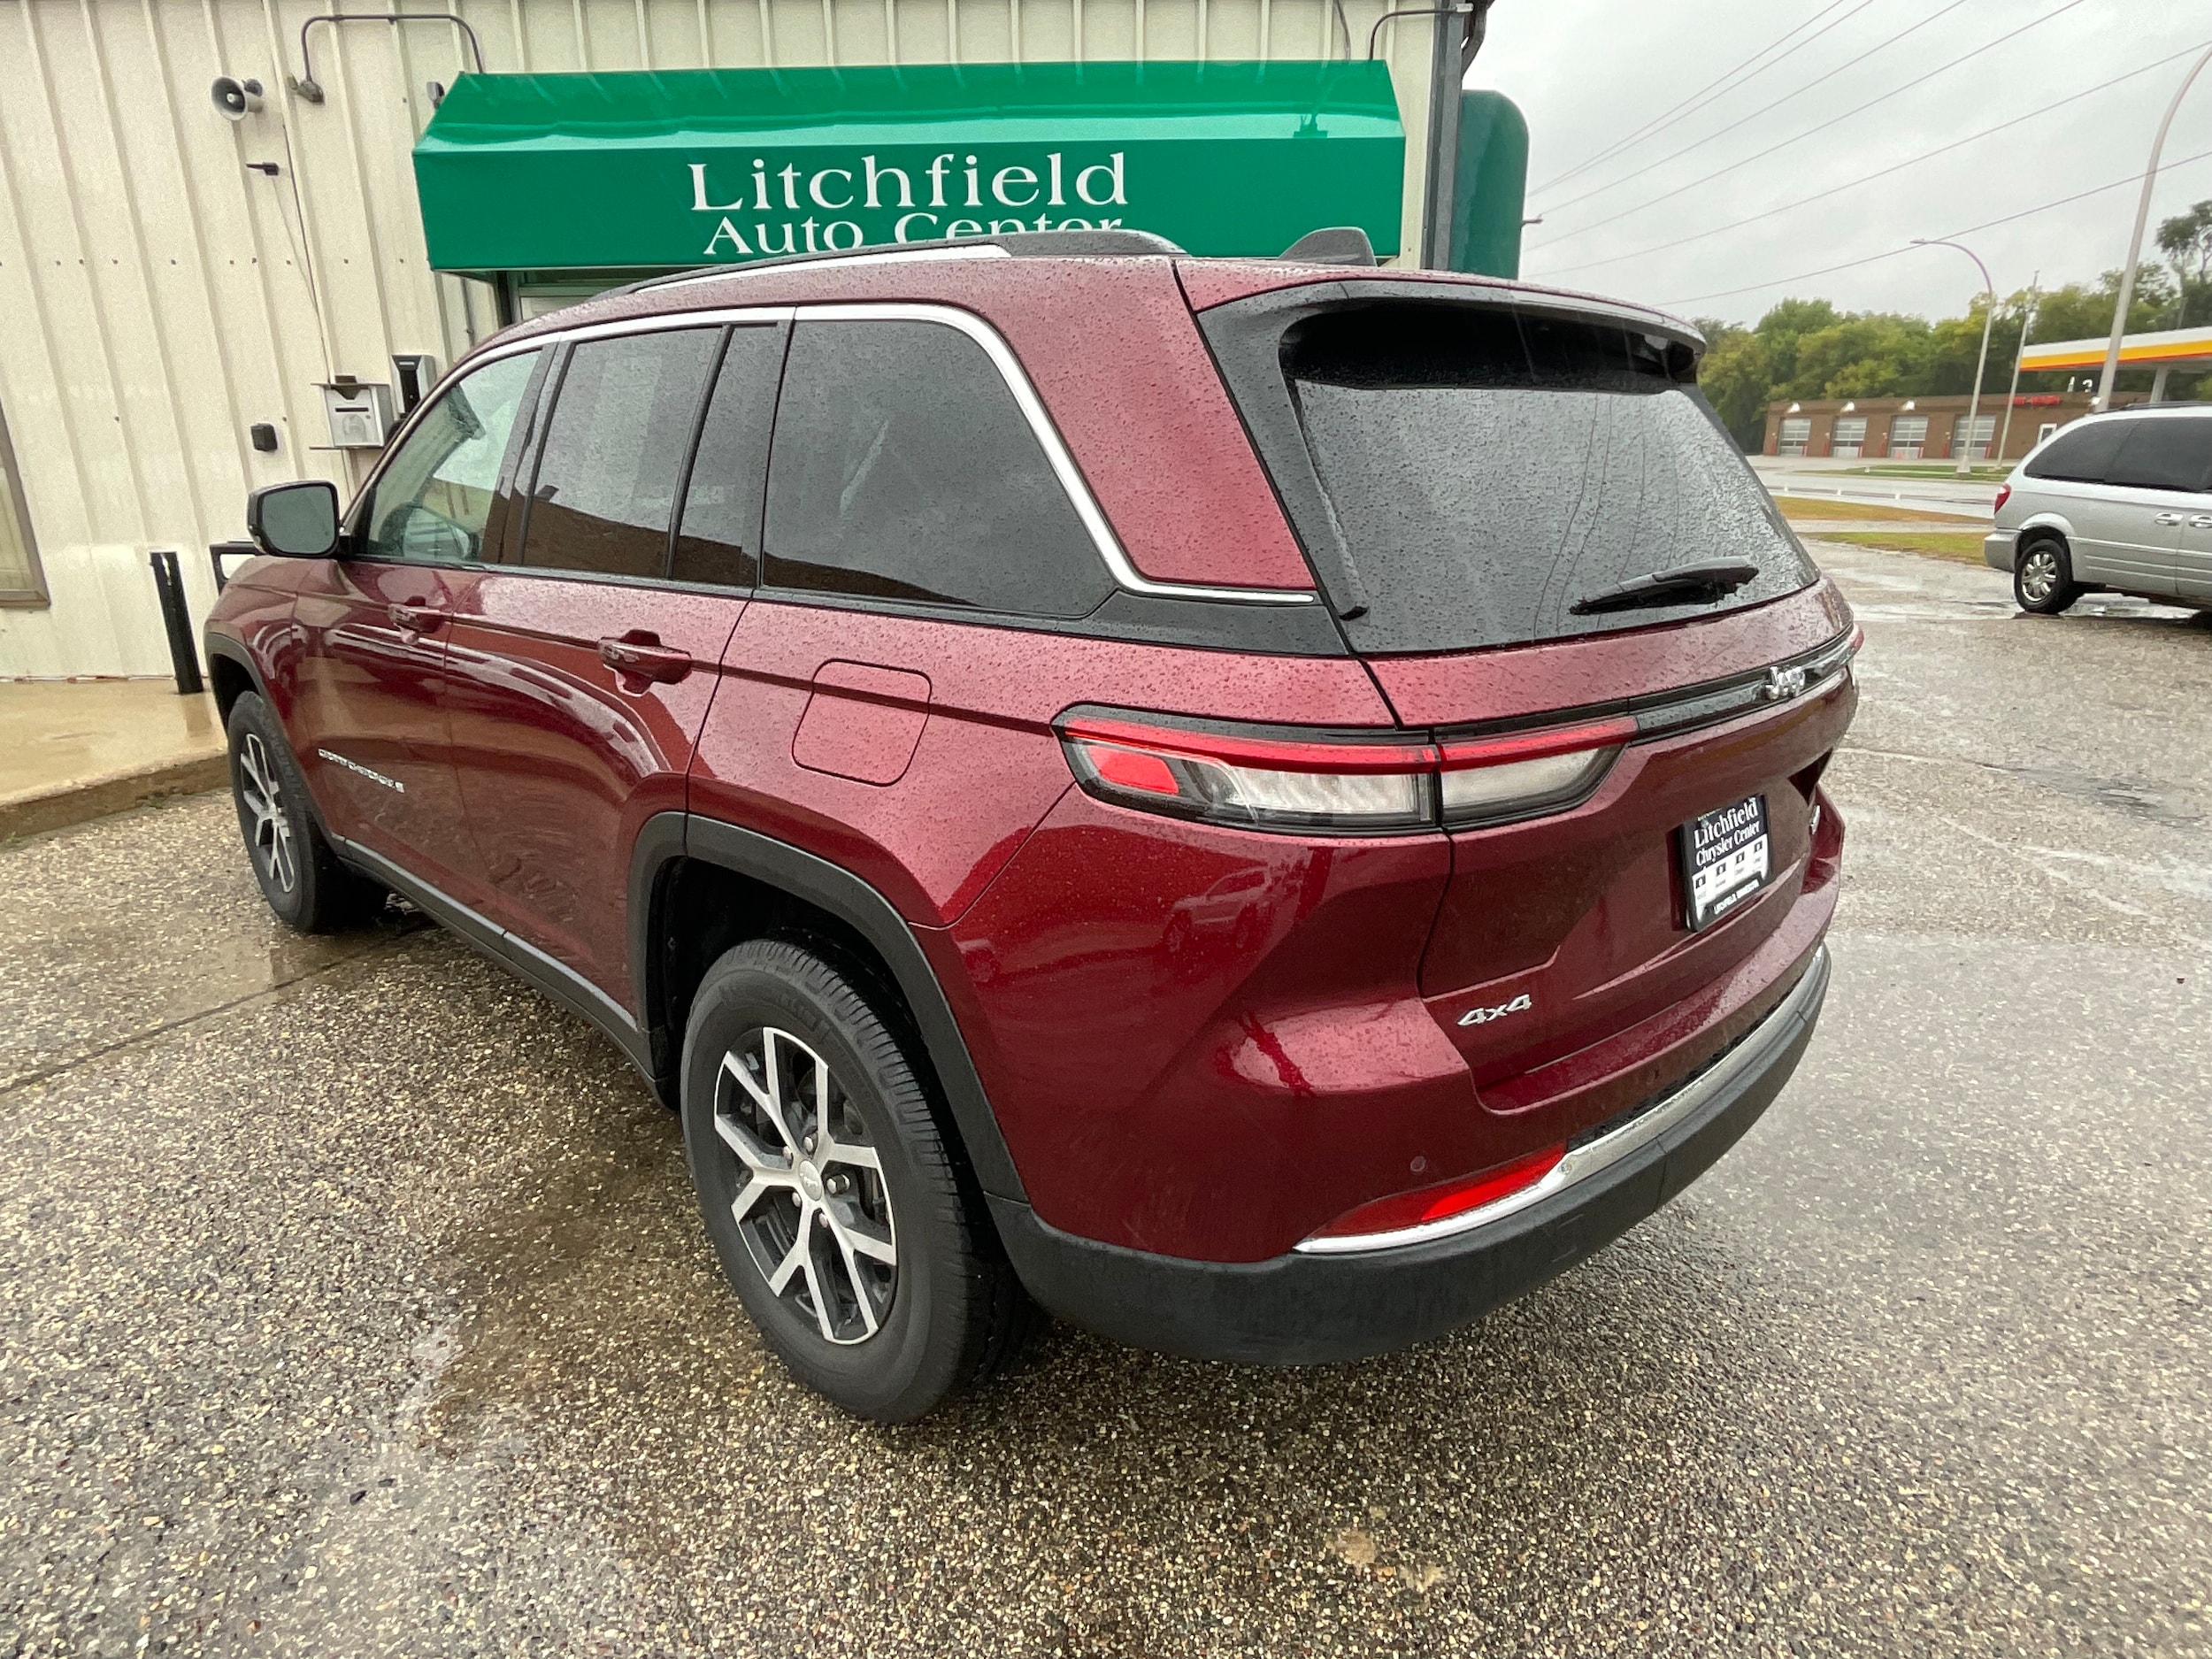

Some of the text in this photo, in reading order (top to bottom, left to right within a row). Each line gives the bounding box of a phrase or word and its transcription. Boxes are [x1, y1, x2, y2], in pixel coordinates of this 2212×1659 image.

[687, 151, 1128, 211] Litchfield
[703, 216, 864, 254] Auto
[1694, 796, 1759, 849] Litchfield
[1695, 820, 1761, 867] Chrysler Center
[1456, 994, 1532, 1026] 4x4
